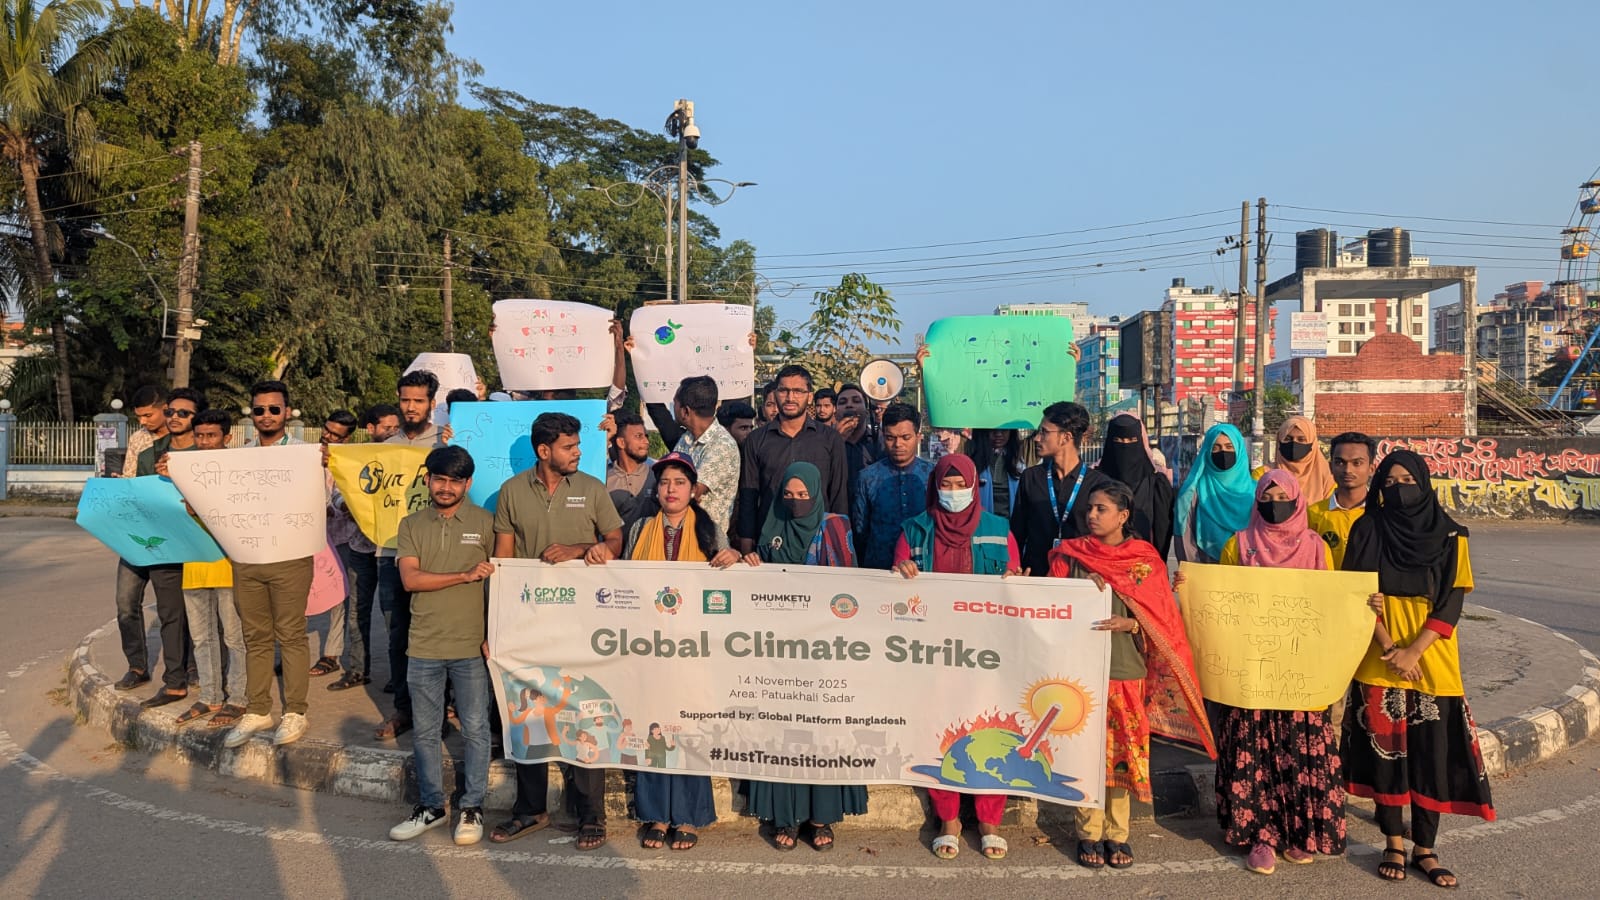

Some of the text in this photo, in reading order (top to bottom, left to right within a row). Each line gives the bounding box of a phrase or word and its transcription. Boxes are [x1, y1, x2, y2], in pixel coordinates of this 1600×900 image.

[1545, 448, 1600, 476] প্রতিবা
[534, 587, 576, 597] GPYDS
[751, 593, 811, 602] DHUMKETU
[591, 628, 1001, 670] Global Climate Strike
[1246, 656, 1310, 690] Talking
[737, 675, 848, 689] 14 November 2025
[729, 689, 855, 703] Area: Patuakhali Sadar
[680, 710, 907, 726] Supported by: Global Platform Bangladesh
[709, 748, 877, 769] #JustTransitionNow
